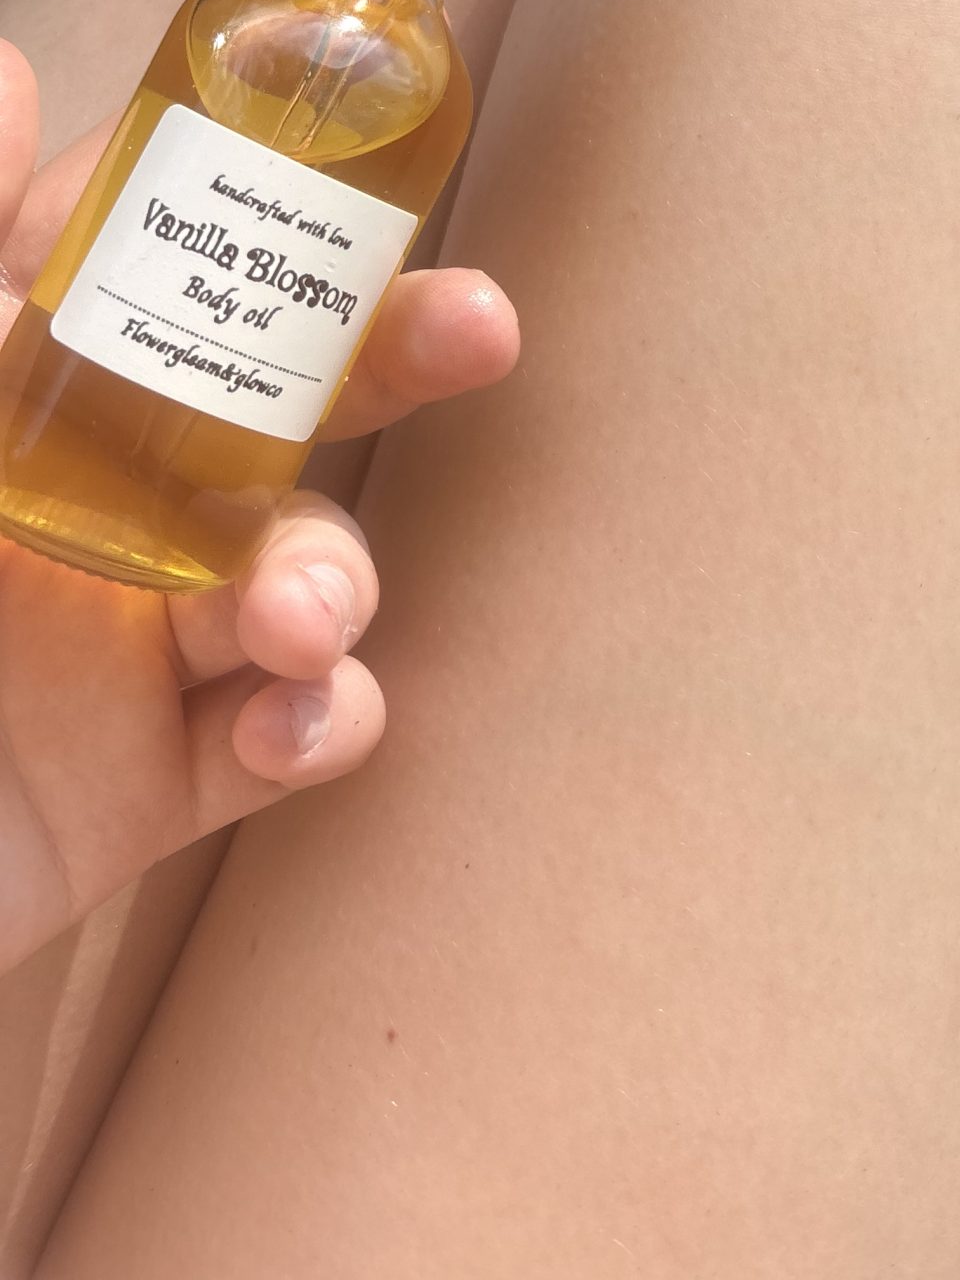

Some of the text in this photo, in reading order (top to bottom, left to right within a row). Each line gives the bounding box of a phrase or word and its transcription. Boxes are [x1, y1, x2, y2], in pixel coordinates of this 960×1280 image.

[210, 174, 352, 251] handcrafted with love
[142, 197, 358, 326] Vanilla Blossom
[181, 275, 283, 331] Body oil
[120, 317, 283, 400] Flowergleam&glowco
